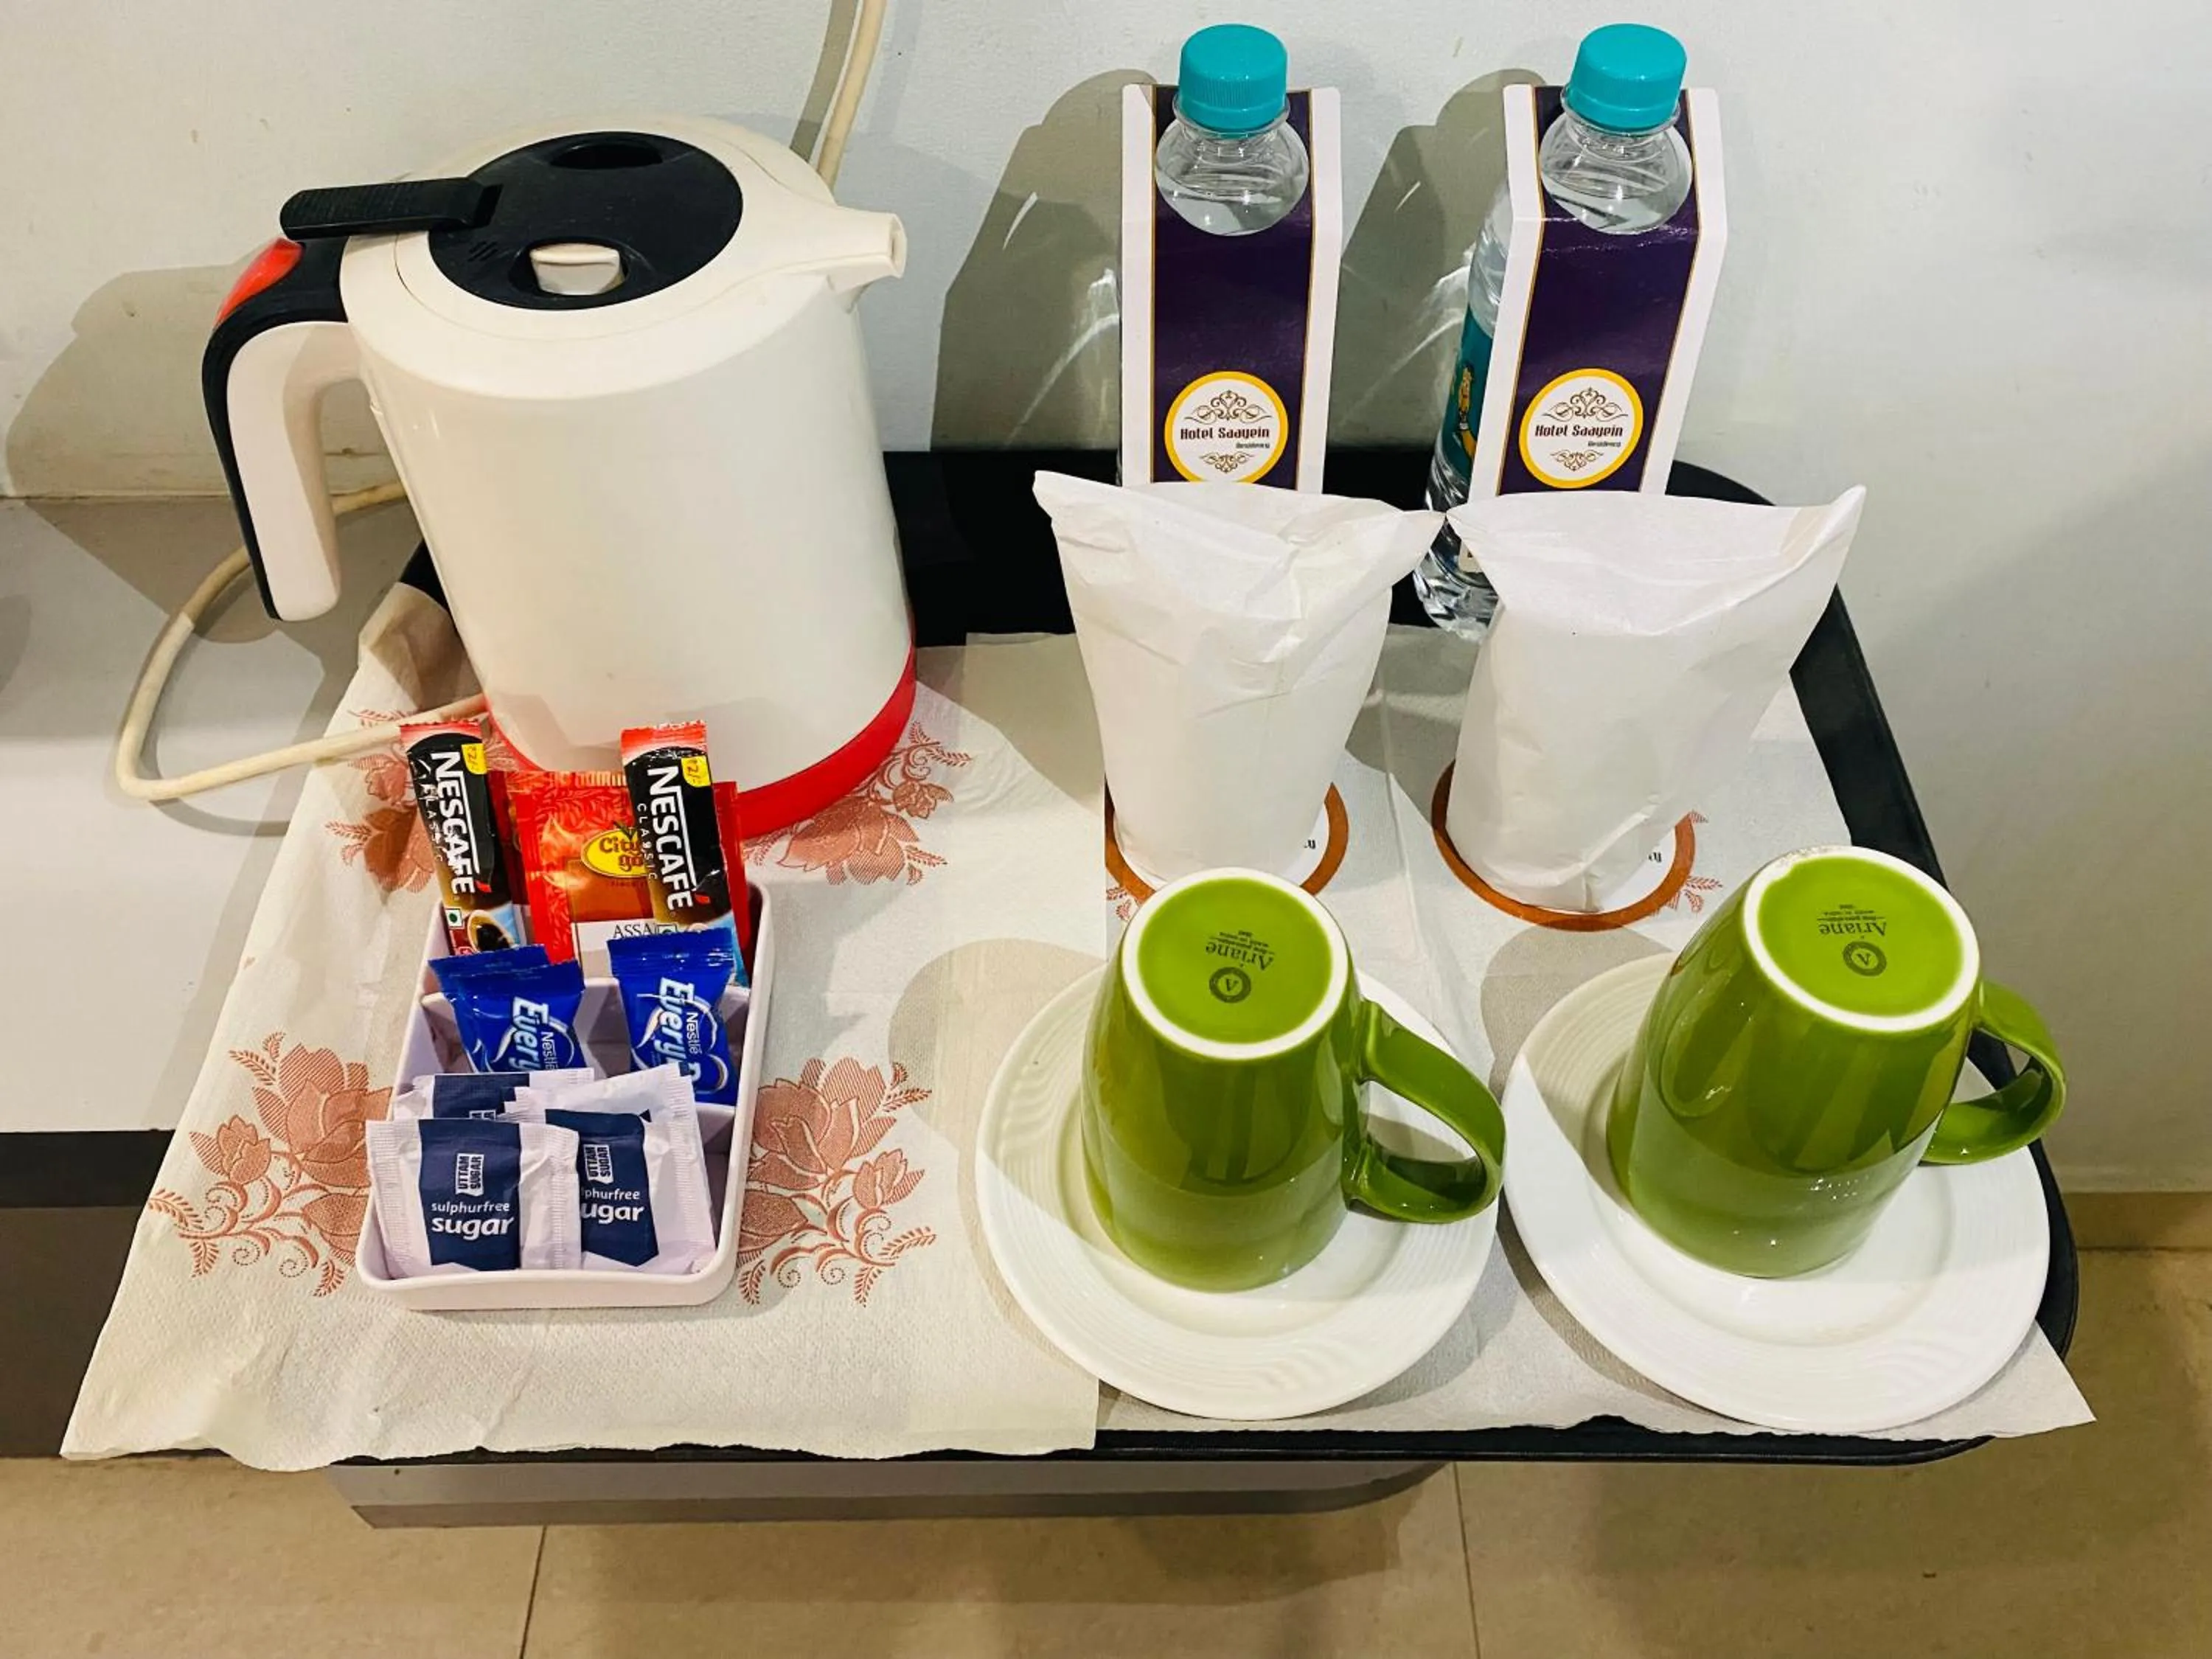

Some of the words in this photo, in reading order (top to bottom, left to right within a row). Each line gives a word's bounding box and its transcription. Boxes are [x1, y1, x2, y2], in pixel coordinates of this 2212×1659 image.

[1180, 427, 1214, 439] Hotel
[1218, 427, 1270, 439] Saayein
[1534, 425, 1568, 437] Hotel
[1572, 425, 1623, 438] Saayein
[637, 803, 658, 880] CLASSIC
[613, 922, 659, 939] ASSA
[1818, 922, 1887, 939] Ariane
[1206, 942, 1274, 971] Ariane
[458, 1155, 470, 1189] UTTAM
[470, 1155, 482, 1189] SUGAR
[584, 1147, 599, 1178] UTTAM
[597, 1147, 611, 1178] SUGAR
[431, 1200, 510, 1214] sulphurfree
[580, 1203, 645, 1225] ugar
[431, 1217, 515, 1241] sugar
